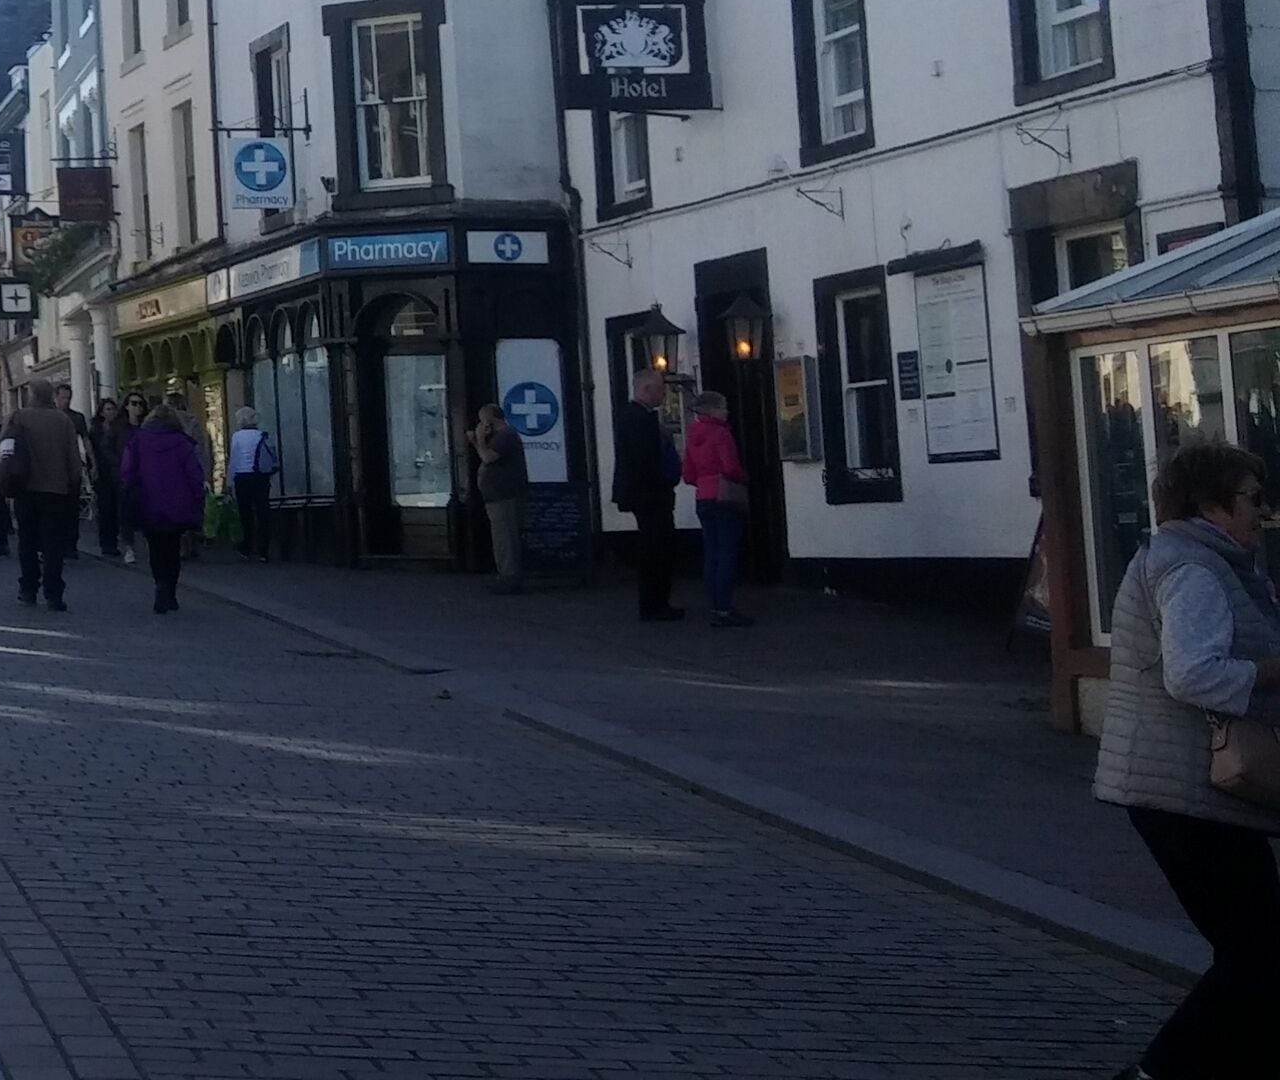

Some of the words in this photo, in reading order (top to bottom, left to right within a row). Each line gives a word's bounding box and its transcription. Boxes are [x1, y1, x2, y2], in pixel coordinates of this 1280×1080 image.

[609, 76, 668, 98] Hotel
[235, 192, 289, 206] Pharmacy
[333, 235, 441, 262] Pharmacy
